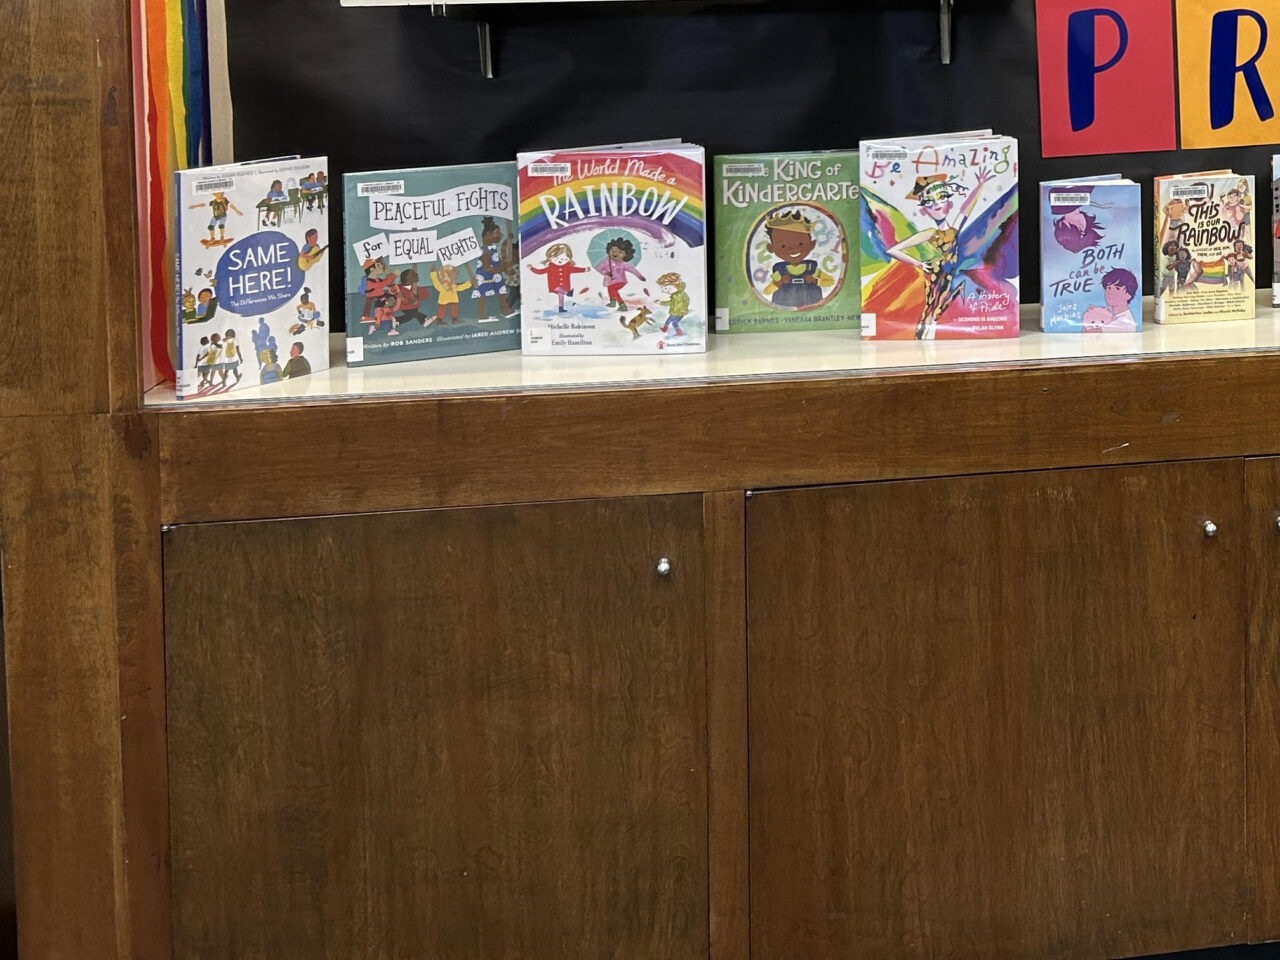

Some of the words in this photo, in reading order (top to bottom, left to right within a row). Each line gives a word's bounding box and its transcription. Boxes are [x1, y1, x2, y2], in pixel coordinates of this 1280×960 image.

[577, 158, 620, 180] World
[625, 158, 666, 182] Made
[667, 175, 676, 186] a
[826, 162, 842, 176] of
[373, 198, 450, 225] PEACEFUL
[538, 181, 689, 230] RAINBOW
[1169, 220, 1246, 247] RAINBOW
[1197, 220, 1205, 228] IS
[1206, 218, 1221, 227] OUR
[228, 242, 290, 271] SAME
[363, 240, 383, 259] for
[394, 237, 434, 260] EQUAL
[438, 235, 478, 262] RIGHTS
[1080, 243, 1125, 270] BOTH
[229, 266, 292, 297] HERE!
[1069, 269, 1089, 280] can
[1093, 264, 1105, 275] be
[967, 291, 976, 302] A
[979, 290, 1010, 306] History
[1050, 277, 1096, 298] TRUE
[969, 301, 978, 315] of
[979, 301, 1007, 313] Pride
